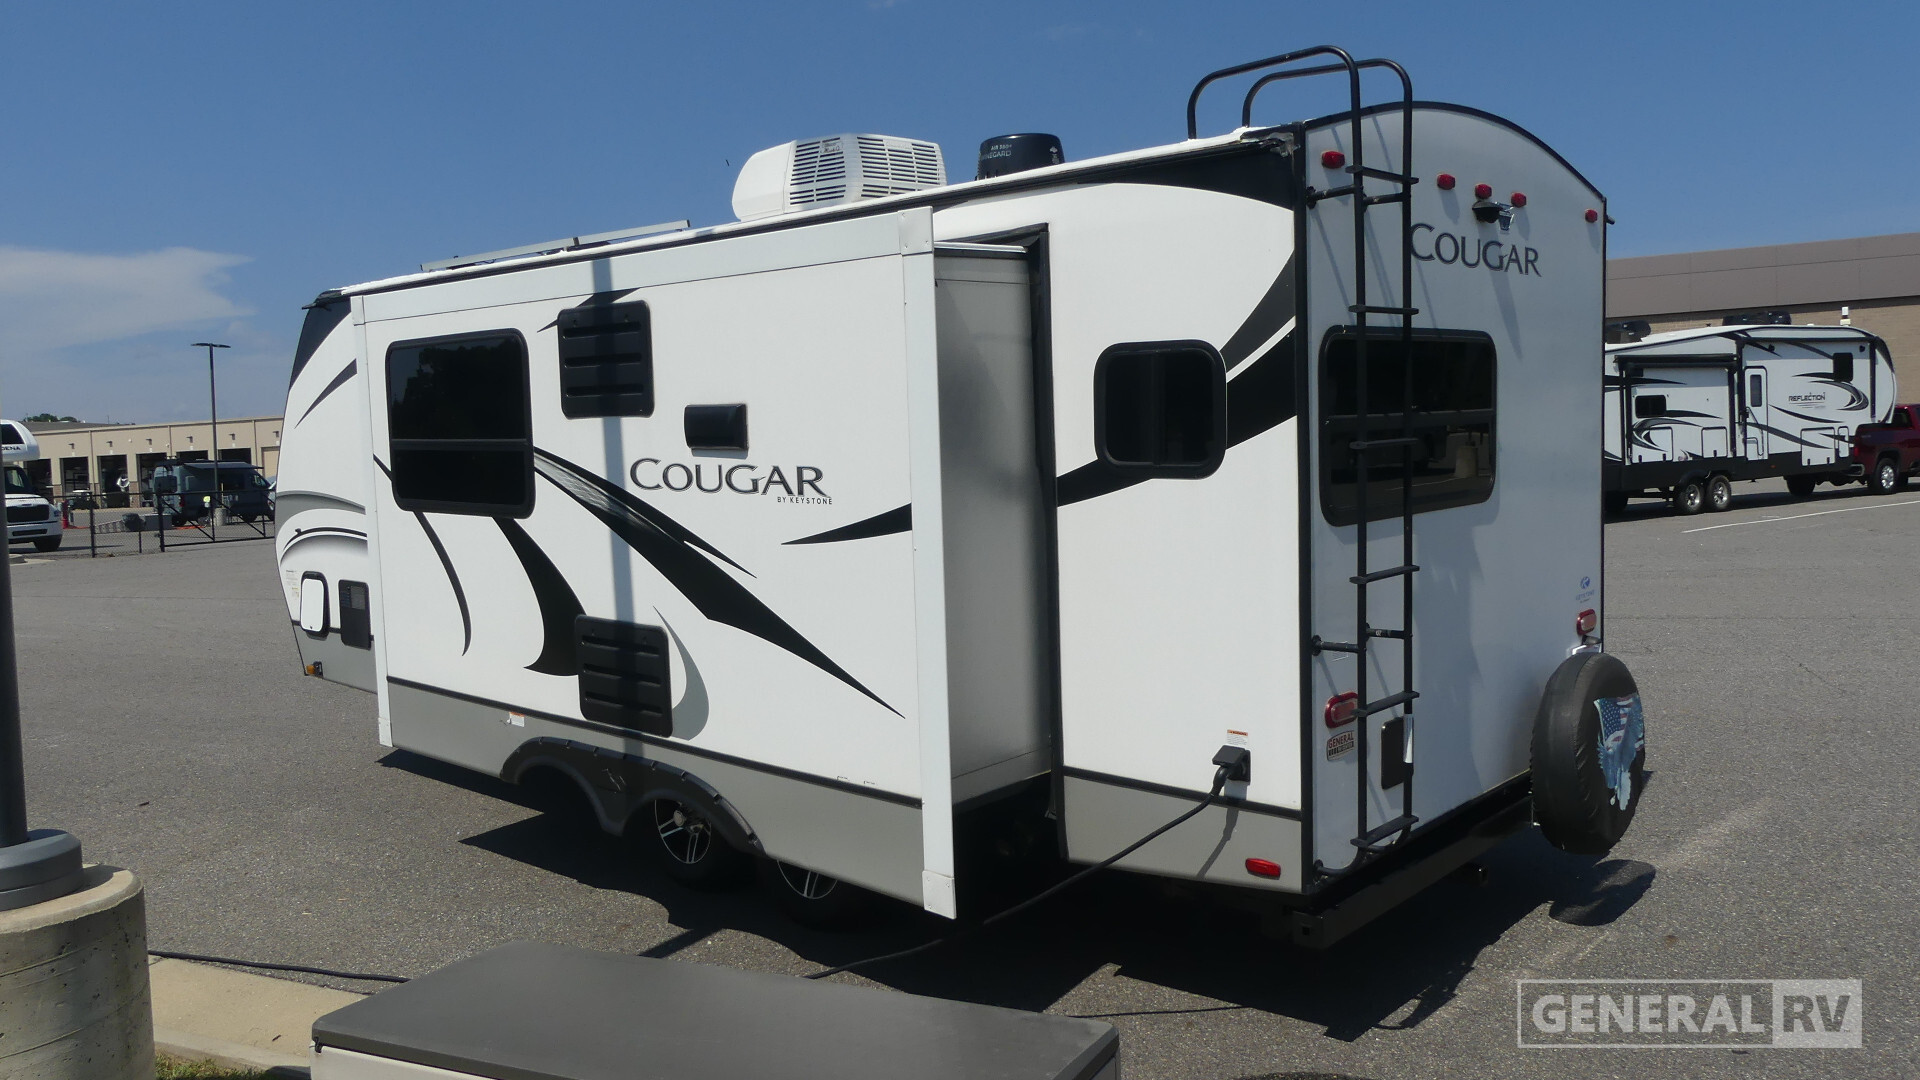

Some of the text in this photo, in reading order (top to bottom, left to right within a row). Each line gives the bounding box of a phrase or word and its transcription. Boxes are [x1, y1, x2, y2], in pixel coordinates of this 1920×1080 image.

[1411, 223, 1542, 277] COUGAR
[1789, 392, 1826, 401] REFLECTION
[630, 457, 831, 498] COUGAR
[790, 496, 833, 505] KEYSTONE
[1328, 732, 1354, 748] GENERAL
